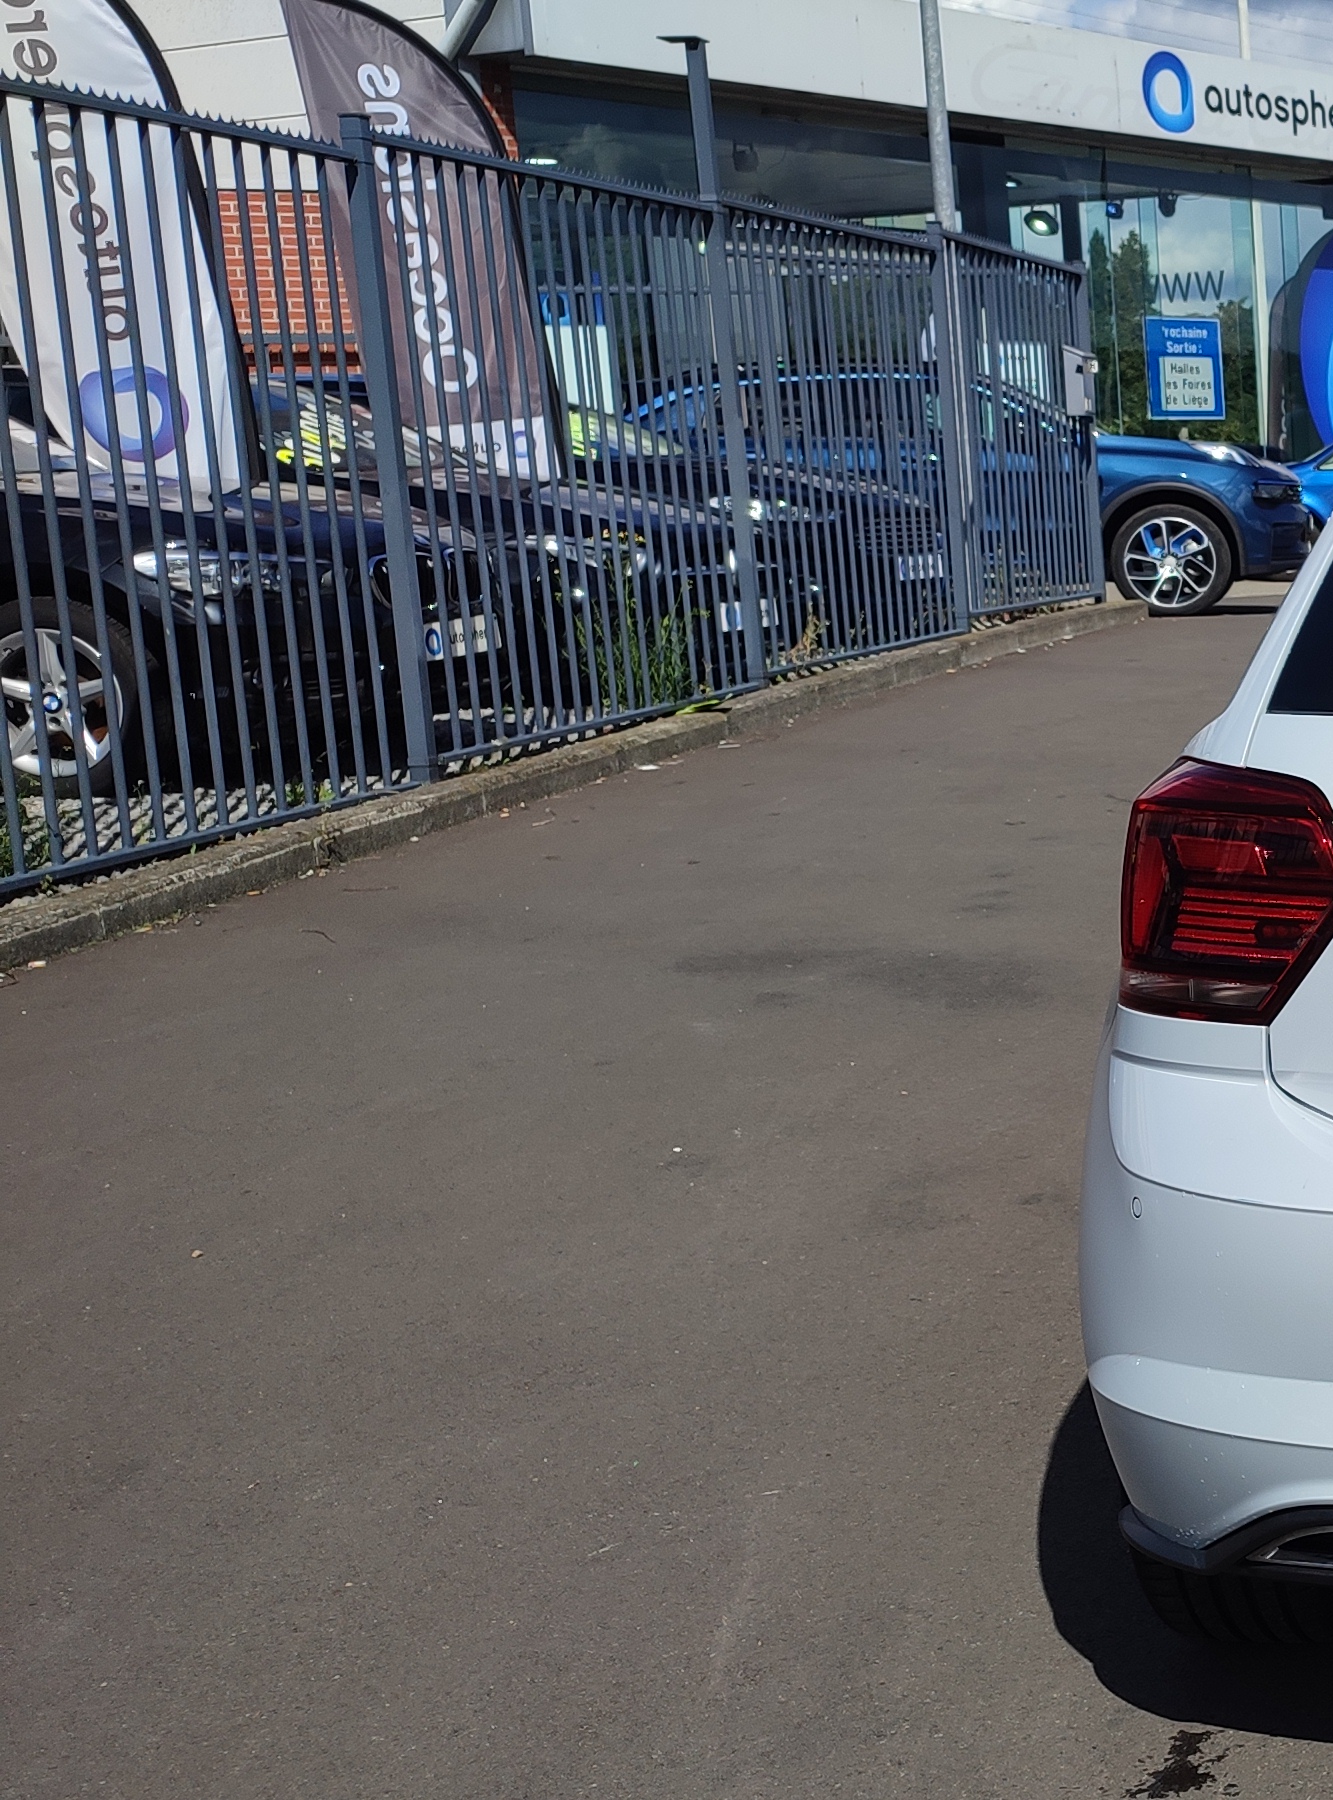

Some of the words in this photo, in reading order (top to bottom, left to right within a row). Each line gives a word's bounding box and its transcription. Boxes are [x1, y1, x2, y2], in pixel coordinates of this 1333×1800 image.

[1161, 325, 1208, 339] rochaine
[1170, 362, 1201, 375] Halles
[1182, 377, 1212, 391] Foires
